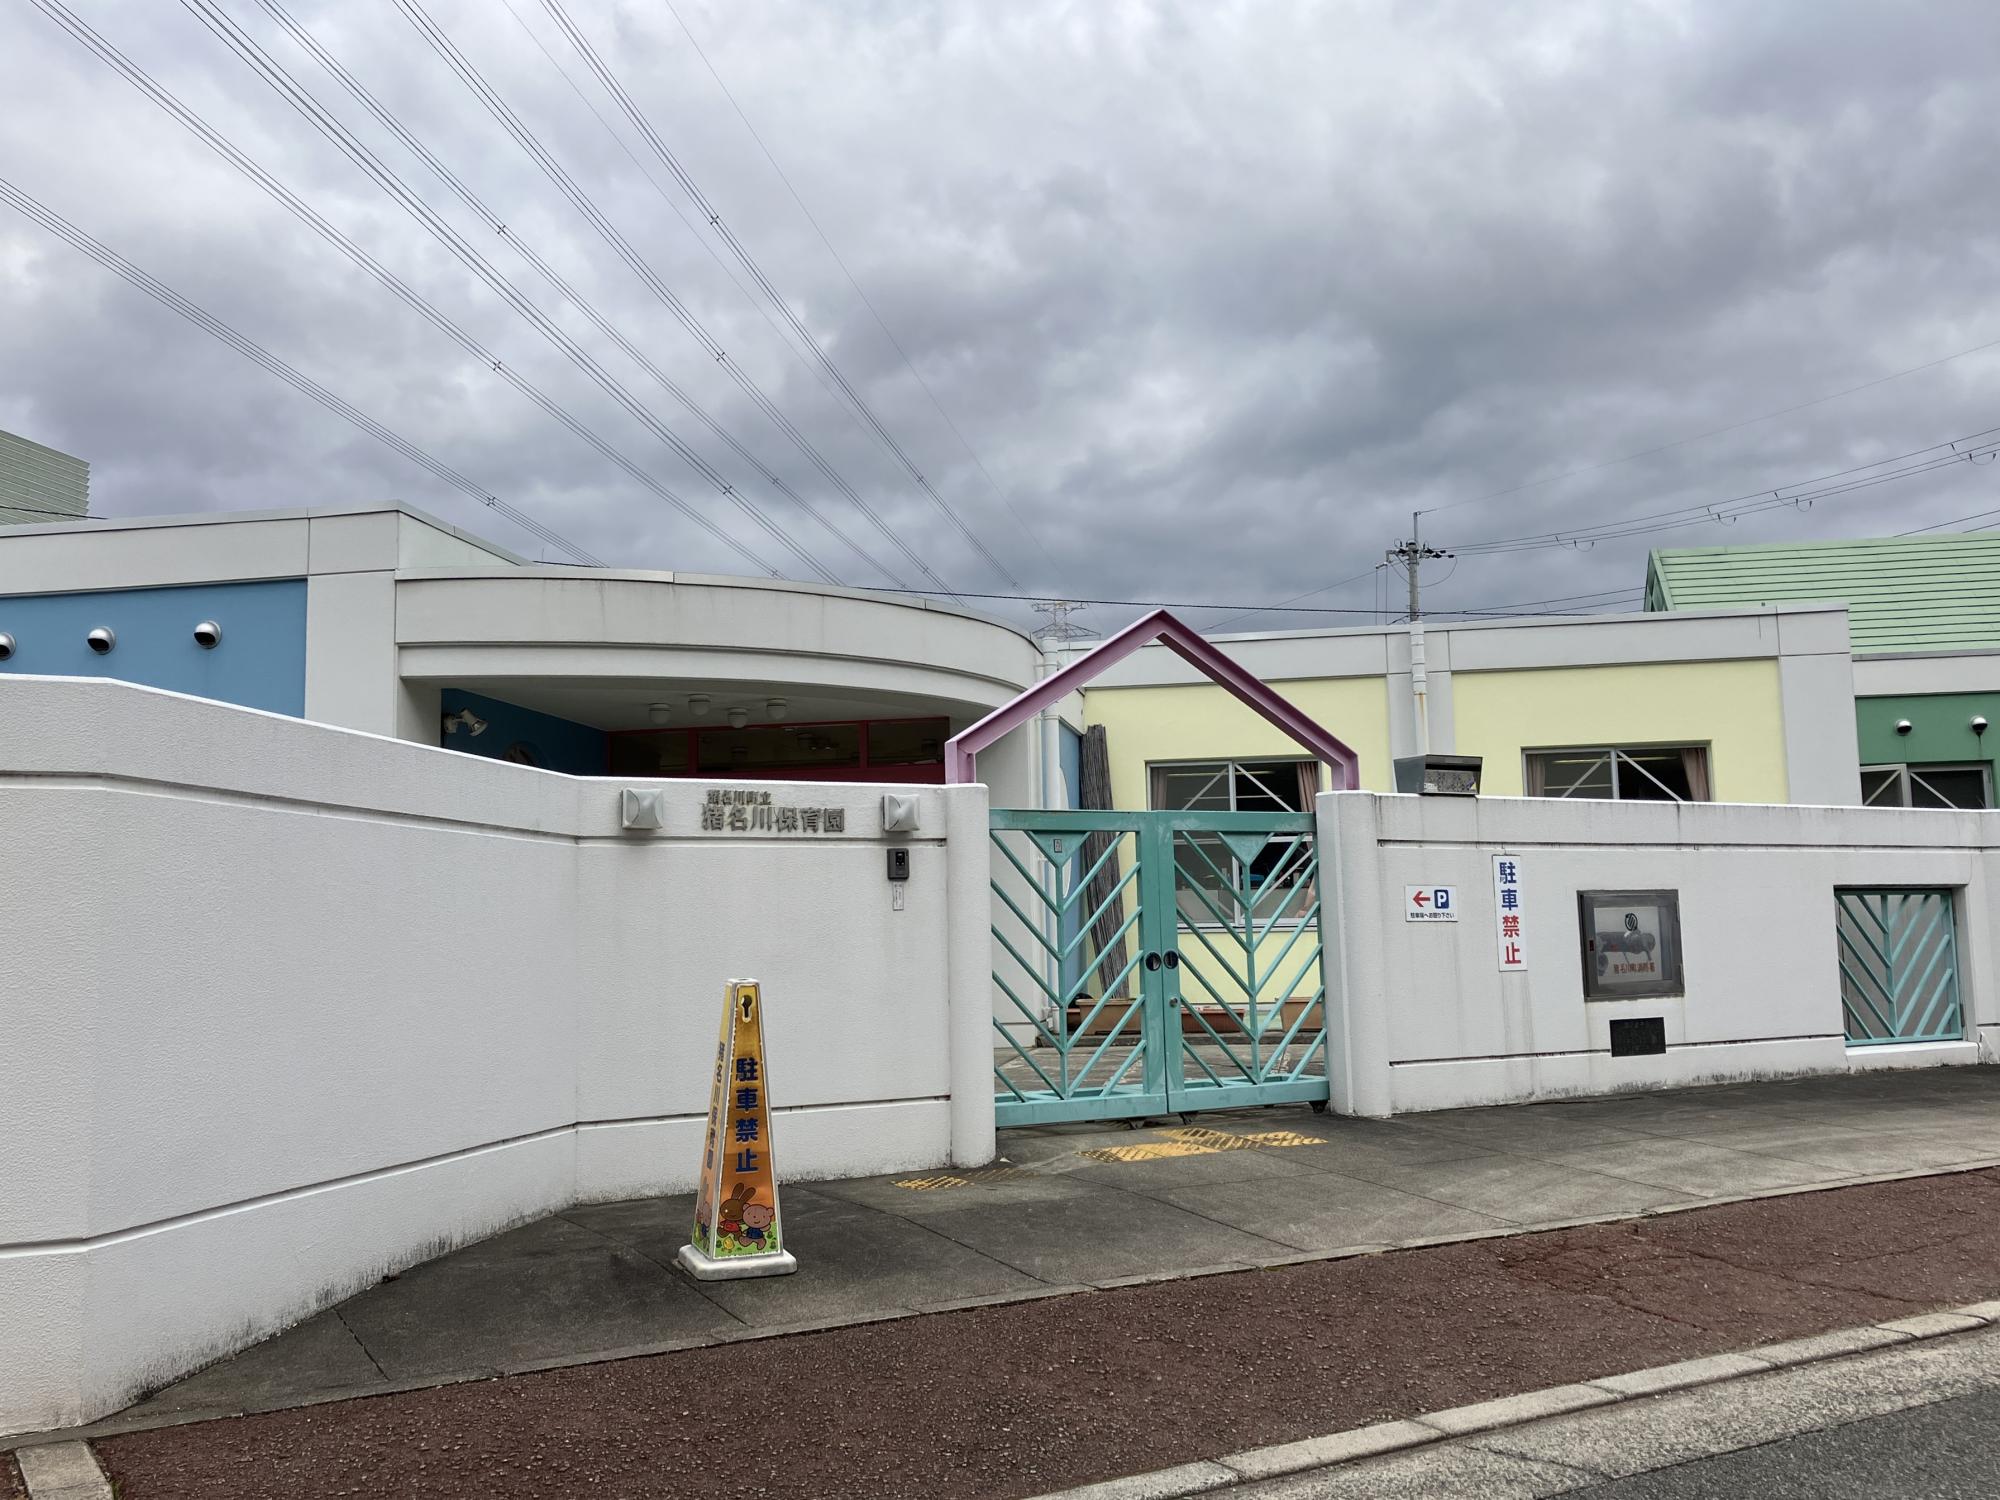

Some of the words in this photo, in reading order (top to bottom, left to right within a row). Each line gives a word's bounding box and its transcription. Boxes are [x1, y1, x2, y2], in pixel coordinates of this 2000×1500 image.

[702, 804, 845, 833] 猪名川保育園
[1436, 891, 1447, 908] P
[1499, 861, 1522, 965] 駐車禁止
[736, 1057, 759, 1172] 駐車禁止
